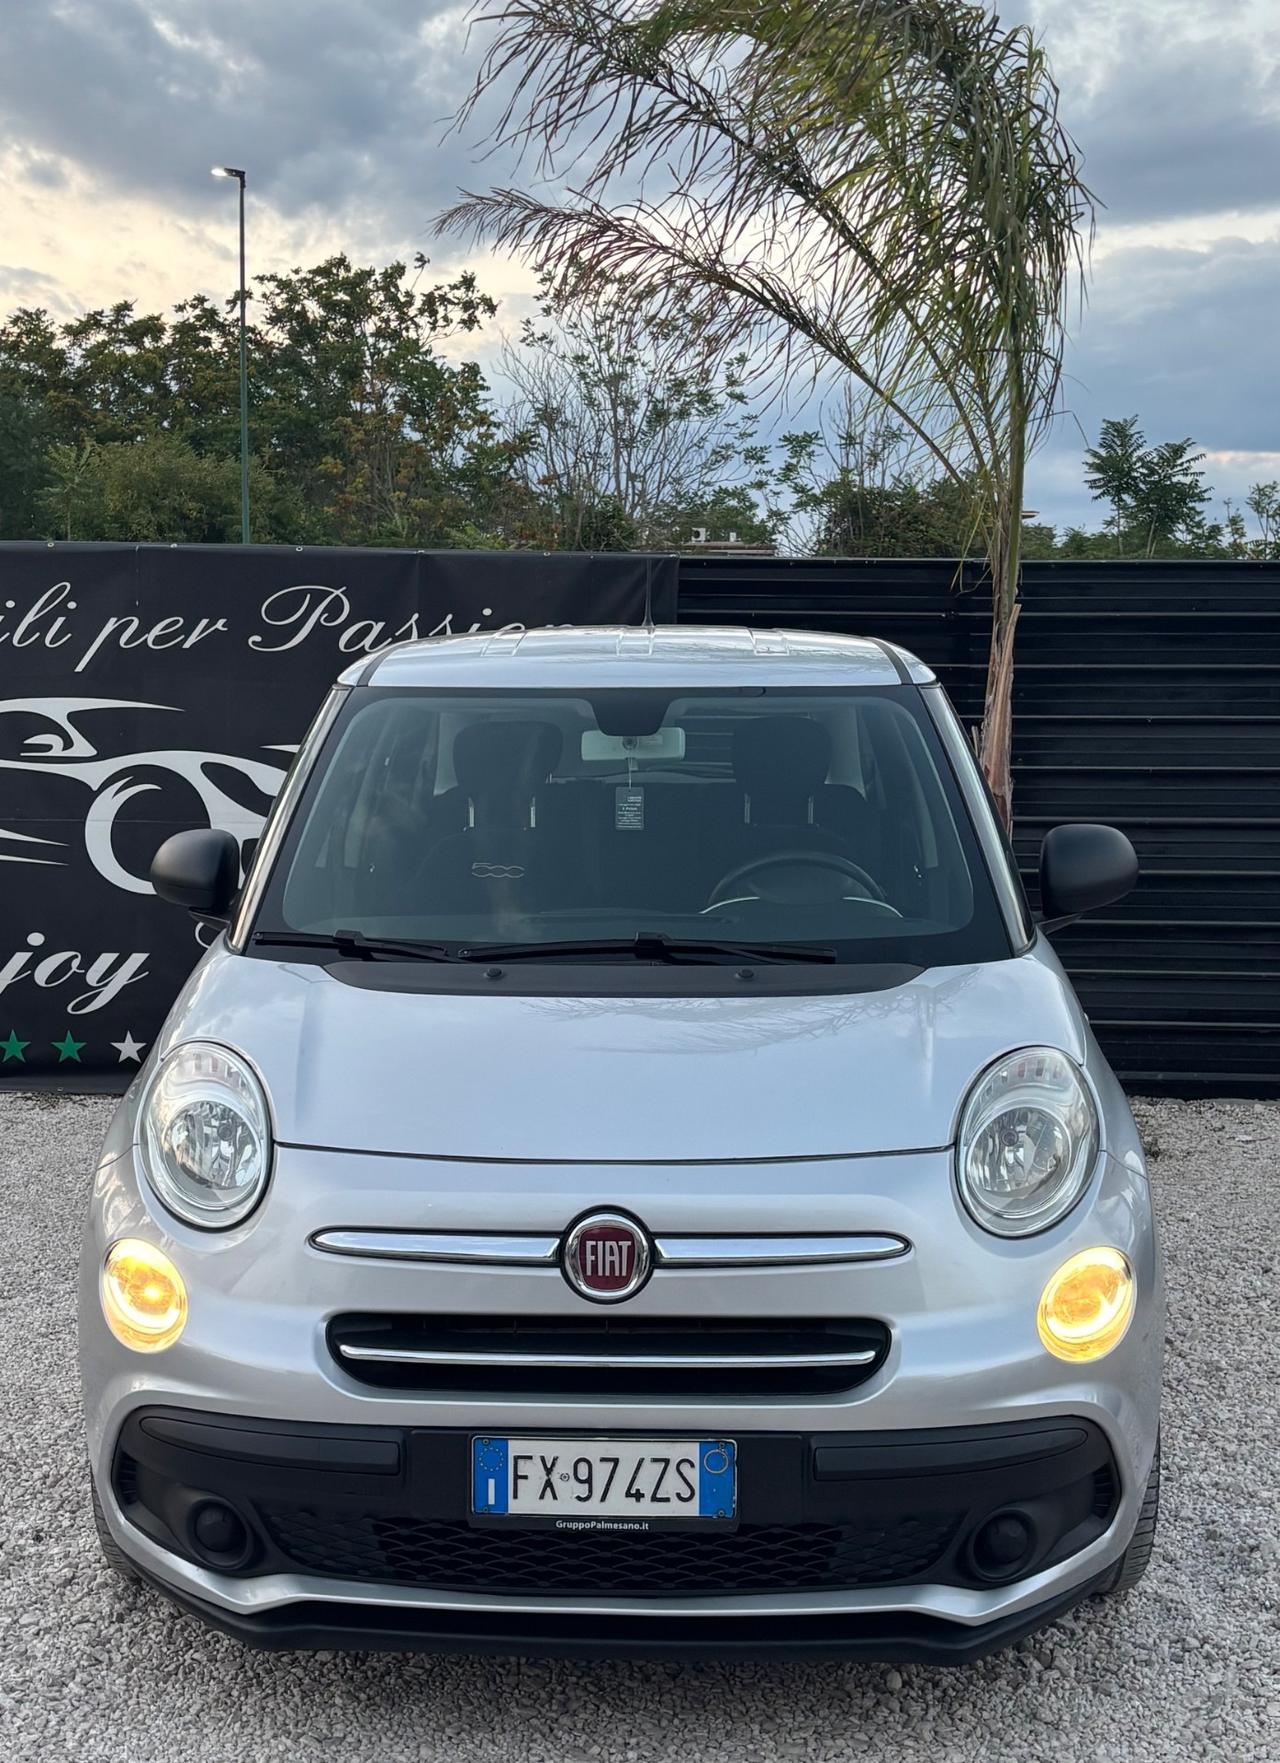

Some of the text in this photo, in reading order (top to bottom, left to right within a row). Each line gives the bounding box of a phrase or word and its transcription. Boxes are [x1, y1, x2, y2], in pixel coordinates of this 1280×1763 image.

[74, 611, 228, 672] per
[586, 1240, 632, 1277] FIAT
[555, 1520, 649, 1531] GruppoPalmesano.it
